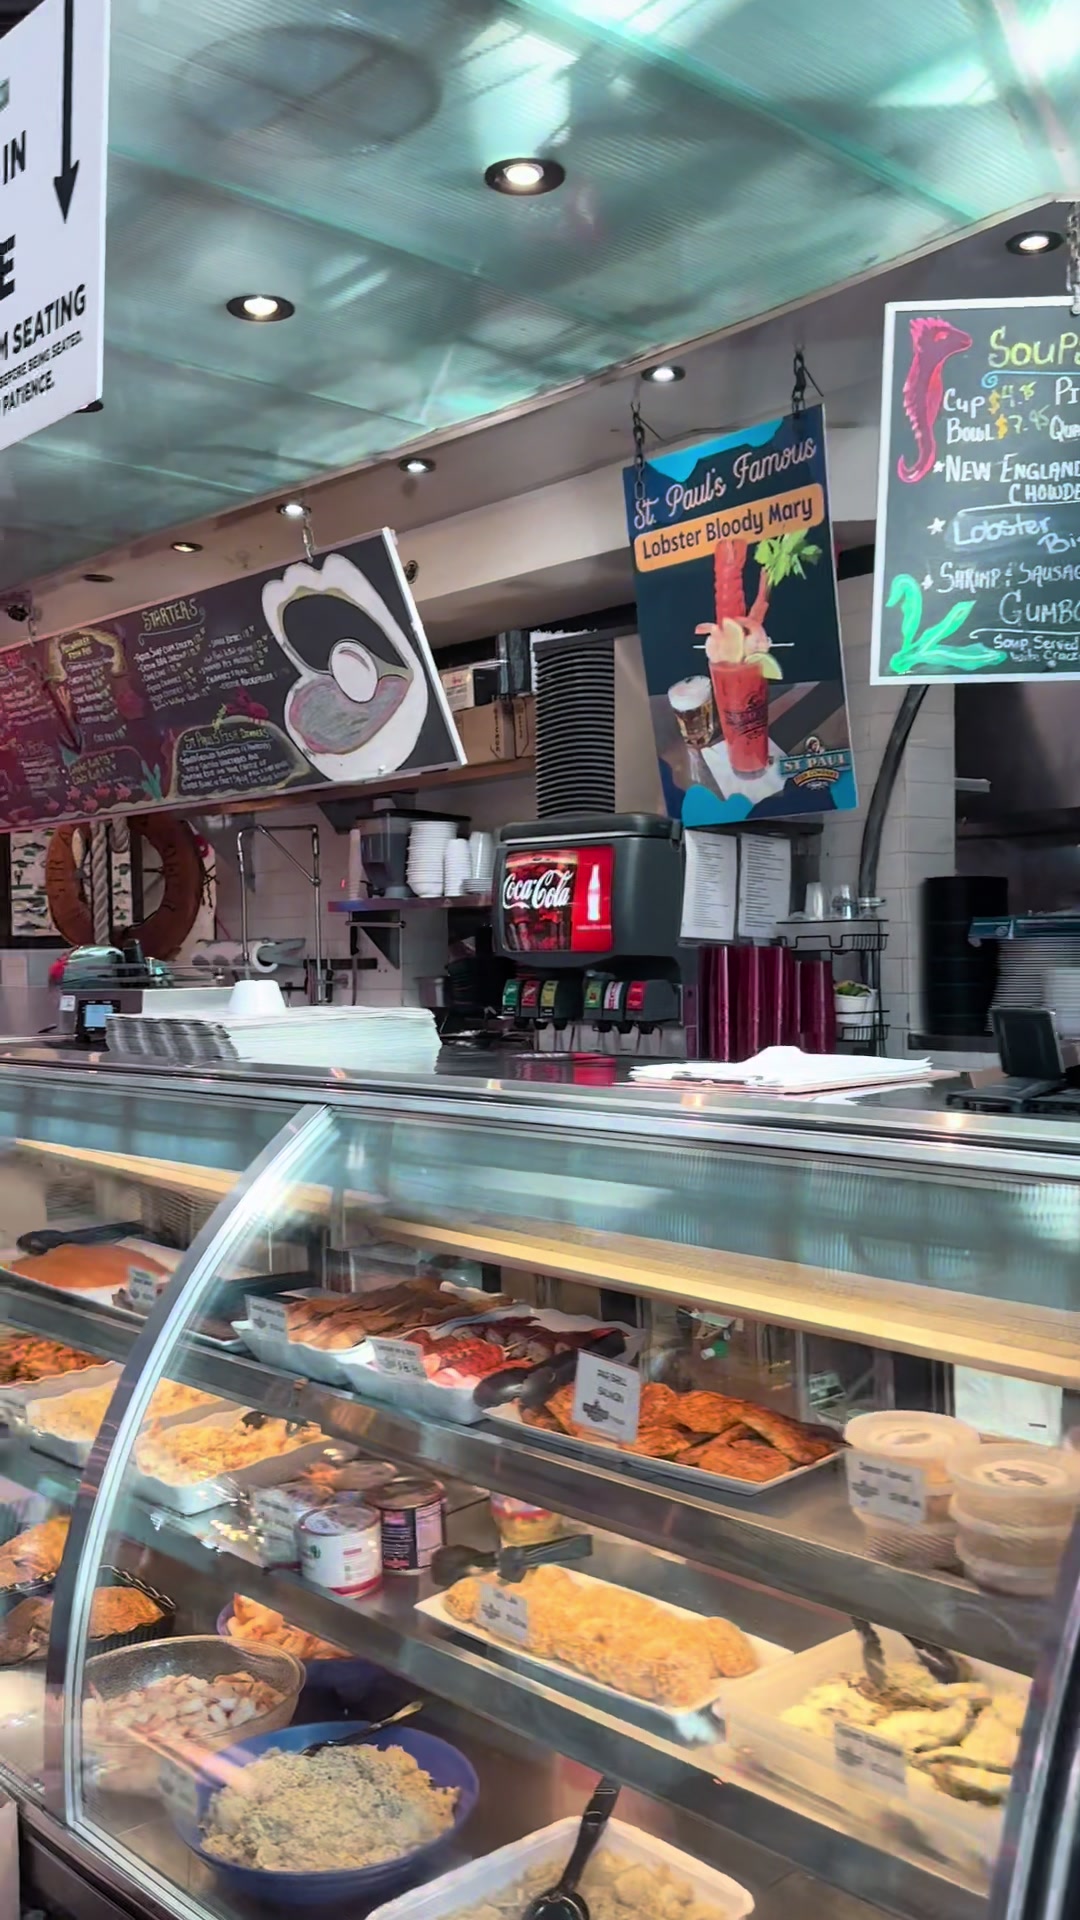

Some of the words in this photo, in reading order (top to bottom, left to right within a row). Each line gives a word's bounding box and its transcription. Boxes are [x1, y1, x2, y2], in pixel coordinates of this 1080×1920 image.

[13, 284, 86, 354] SEATING
[634, 497, 659, 530] St.
[666, 468, 727, 518] Paul's
[732, 436, 817, 490] Famous
[945, 455, 991, 483] NEW
[642, 529, 701, 560] Lobster
[706, 508, 764, 543] Bloody
[768, 497, 814, 525] Mary
[952, 513, 1051, 546] Lobster
[142, 598, 198, 632] STARTERS
[993, 633, 1028, 651] Soup
[503, 869, 574, 910] Coca-Cola
